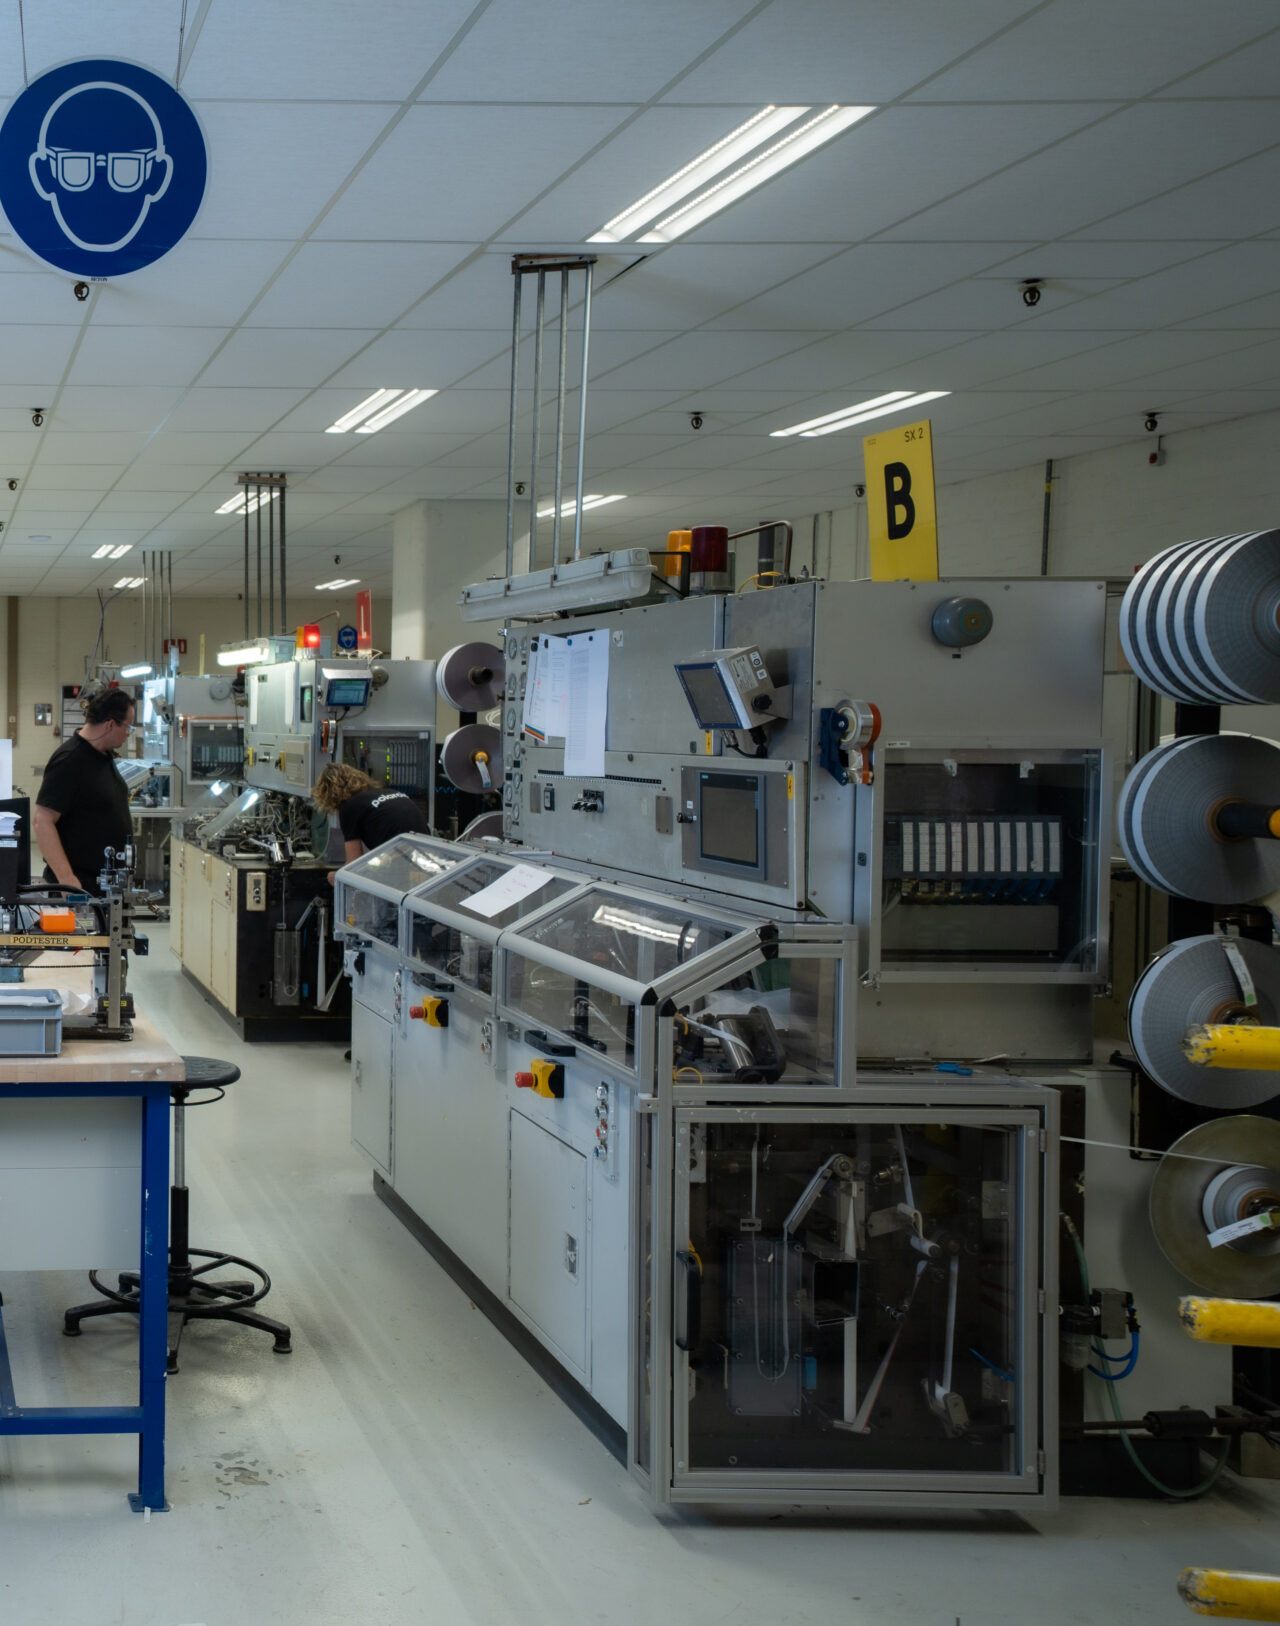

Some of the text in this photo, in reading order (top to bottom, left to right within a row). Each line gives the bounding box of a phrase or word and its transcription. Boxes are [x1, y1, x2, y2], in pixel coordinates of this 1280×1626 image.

[905, 428, 924, 442] SX 2
[884, 462, 915, 540] B
[371, 792, 409, 808] polaro
[13, 936, 69, 945] PODTESTER
